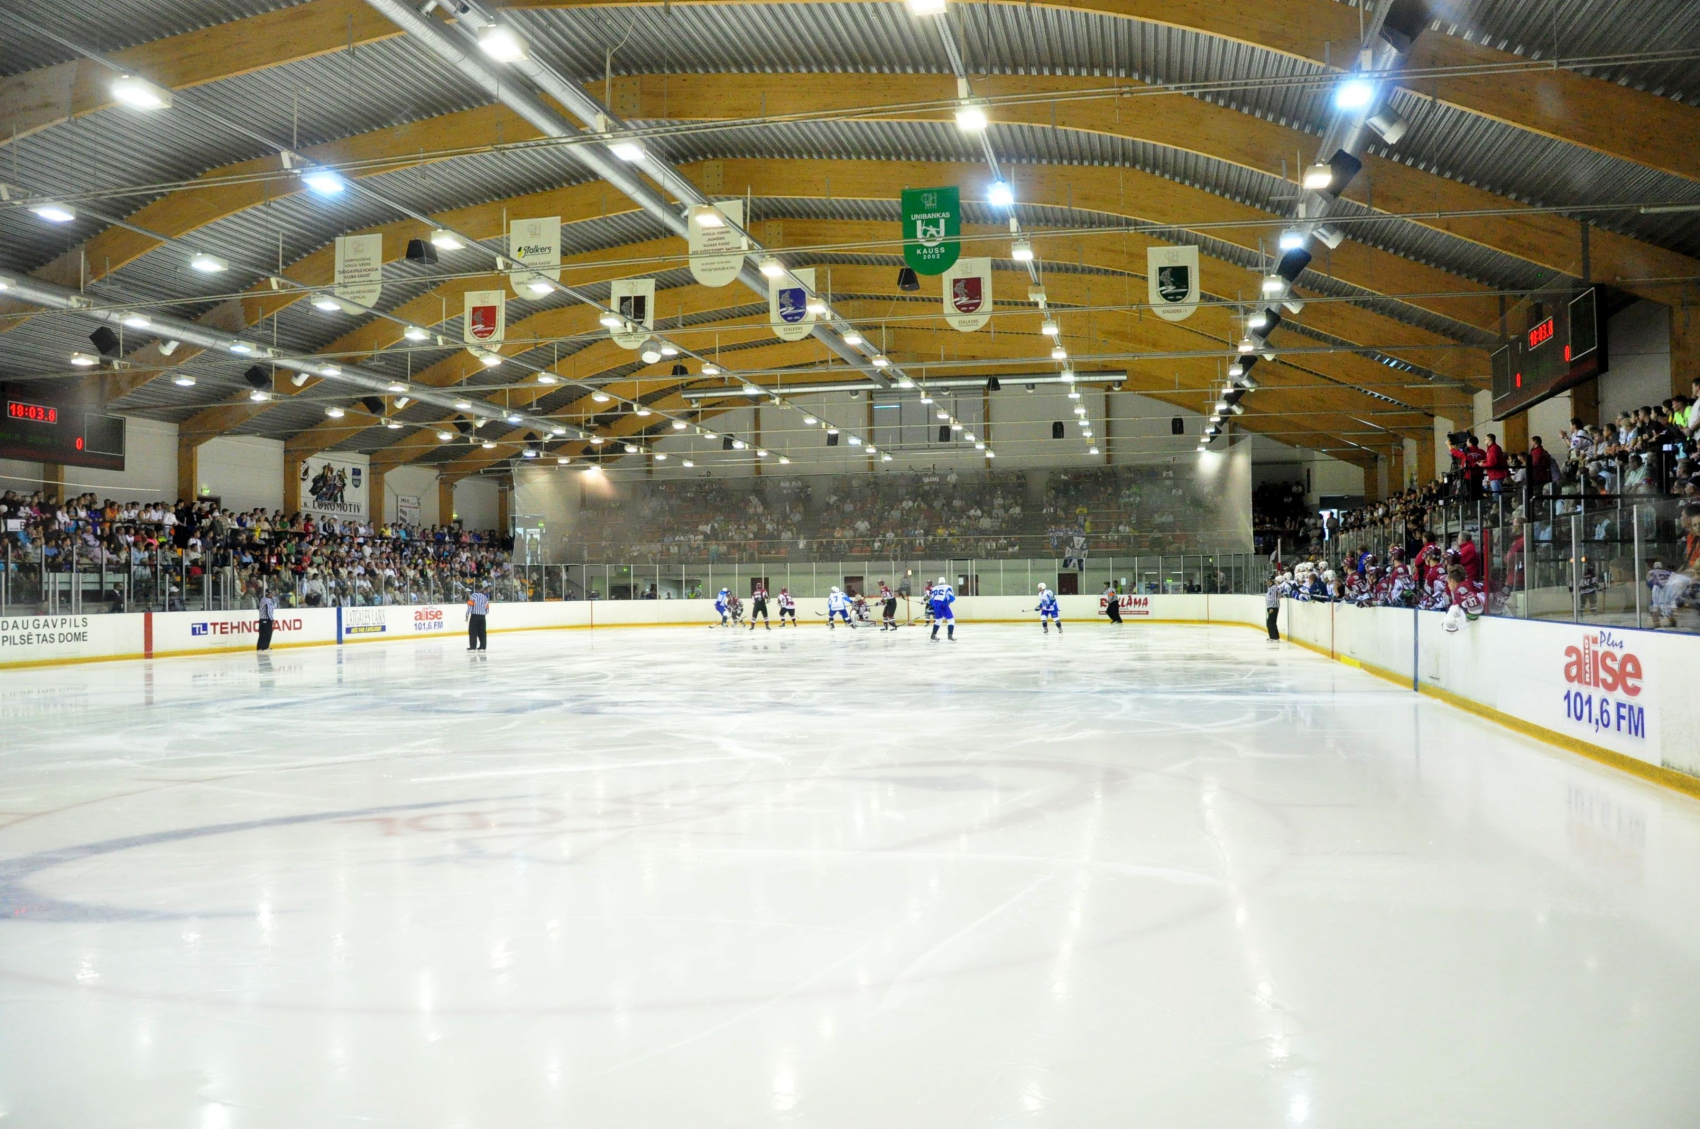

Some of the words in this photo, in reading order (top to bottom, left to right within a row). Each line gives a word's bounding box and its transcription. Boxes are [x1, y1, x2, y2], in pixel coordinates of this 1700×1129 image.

[911, 212, 950, 221] UNIBANKAS
[523, 245, 552, 259] Stalkers
[916, 247, 945, 255] KAUSS
[9, 402, 57, 423] 18:03.8
[75, 437, 84, 450] 0
[312, 499, 362, 514] LOKOMOTIV
[1100, 594, 1149, 608] RLĀMA
[1, 617, 88, 631] DAUGAVPILS
[191, 623, 208, 635] TL
[210, 619, 302, 635] TEHNOAND
[414, 622, 433, 631] 101,6
[433, 621, 444, 630] FM
[58, 631, 88, 643] DOME
[1599, 630, 1624, 649] Plus
[1563, 634, 1643, 697] alise
[1563, 689, 1611, 733] 101,6
[1616, 701, 1645, 739] FM
